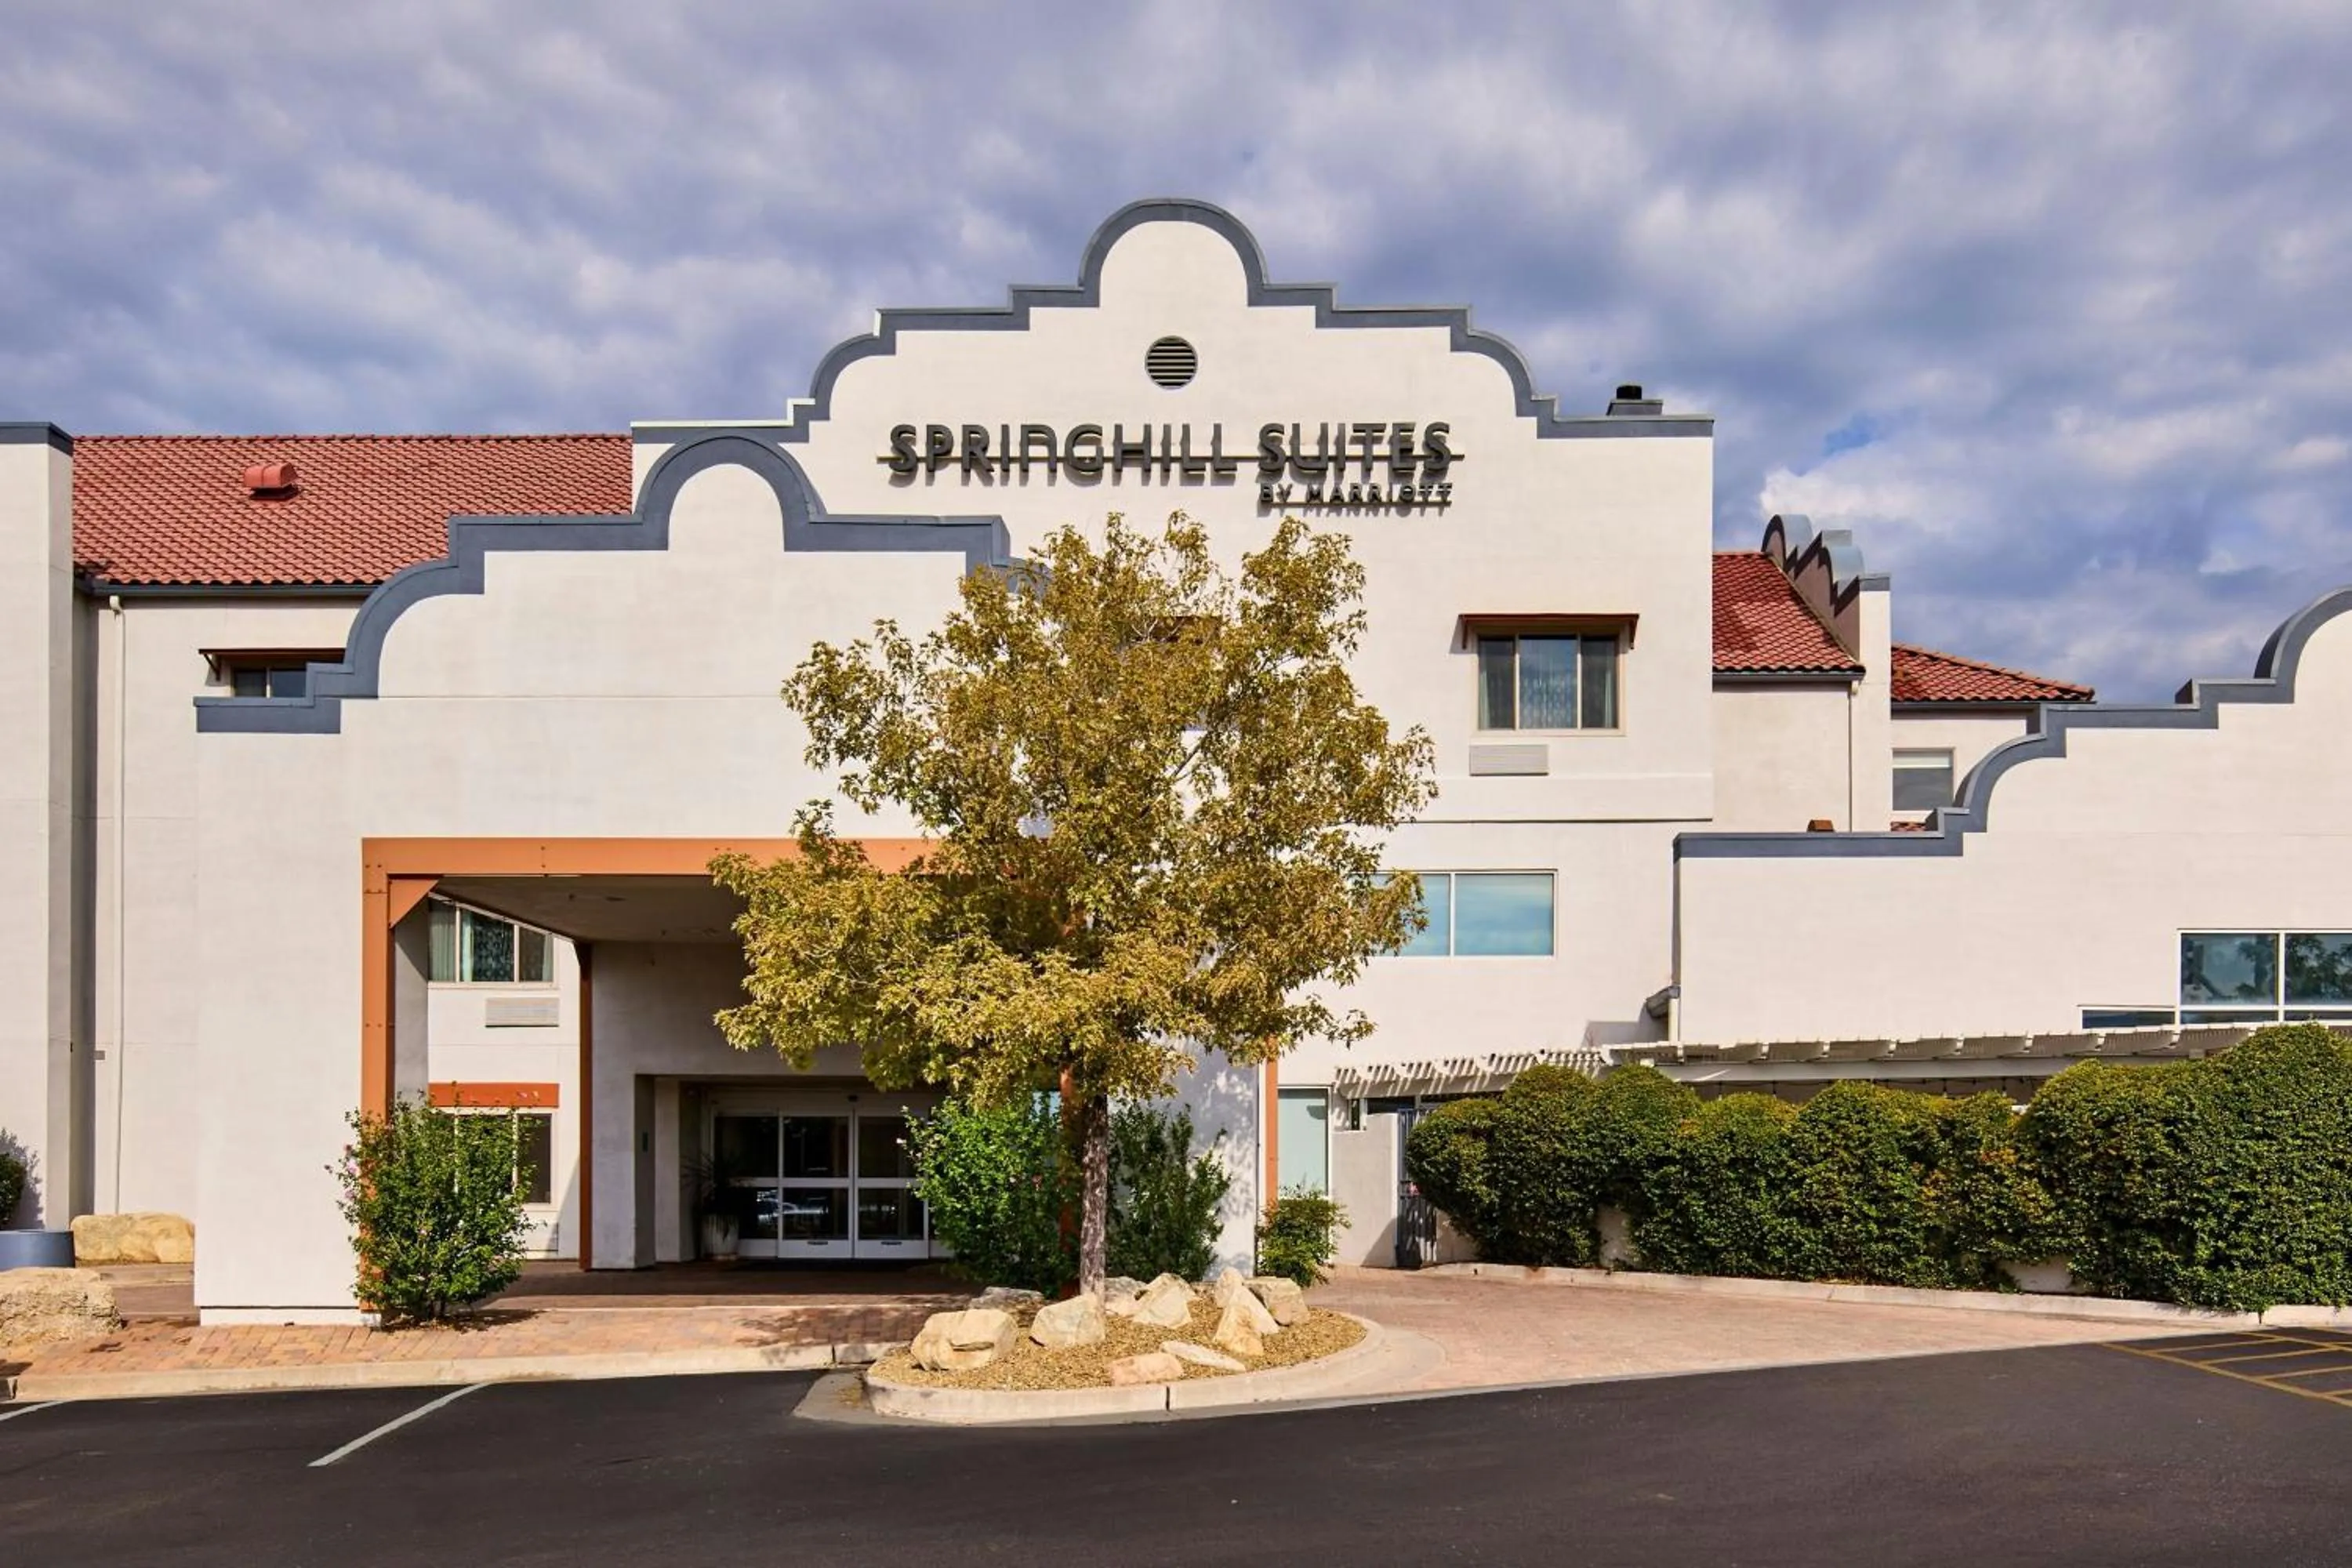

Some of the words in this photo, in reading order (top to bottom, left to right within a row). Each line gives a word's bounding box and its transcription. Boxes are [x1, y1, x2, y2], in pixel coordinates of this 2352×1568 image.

[1258, 422, 1451, 471] SUITES
[1260, 483, 1293, 503] BY
[1305, 482, 1452, 503] MARRIOTT
